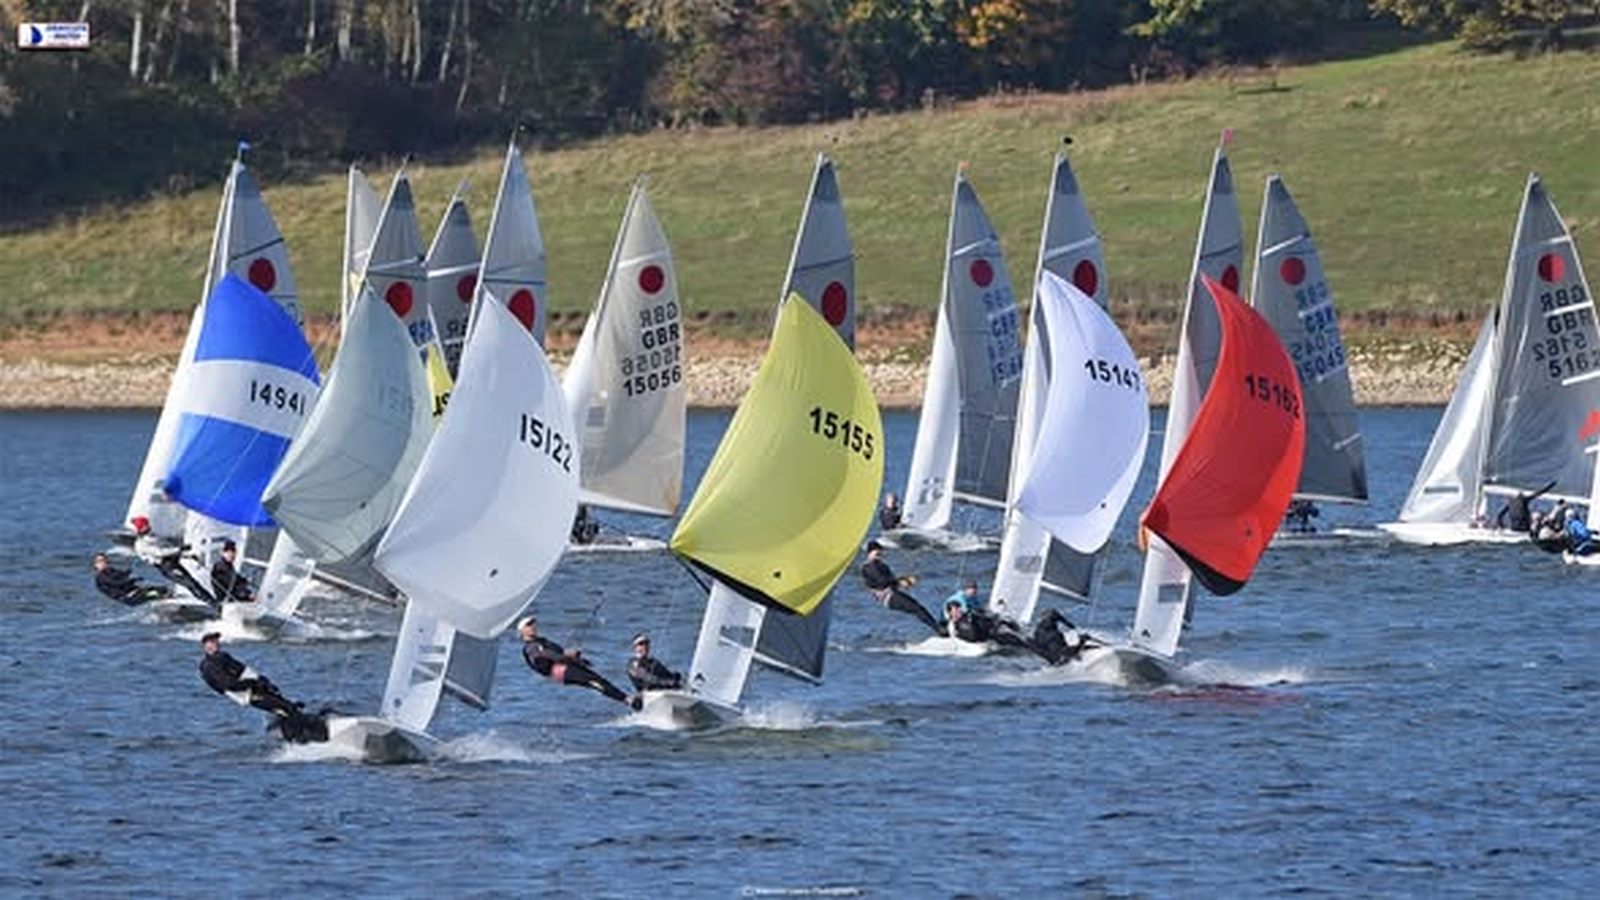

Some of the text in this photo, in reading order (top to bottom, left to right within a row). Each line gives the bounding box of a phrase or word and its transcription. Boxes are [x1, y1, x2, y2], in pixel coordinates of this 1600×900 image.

[641, 322, 680, 350] GBR
[623, 365, 682, 397] 15056
[1085, 359, 1140, 392] 15147
[251, 379, 306, 416] 14941
[1244, 374, 1300, 419] 15162
[521, 413, 573, 473] 15122
[810, 406, 874, 461] 15155
